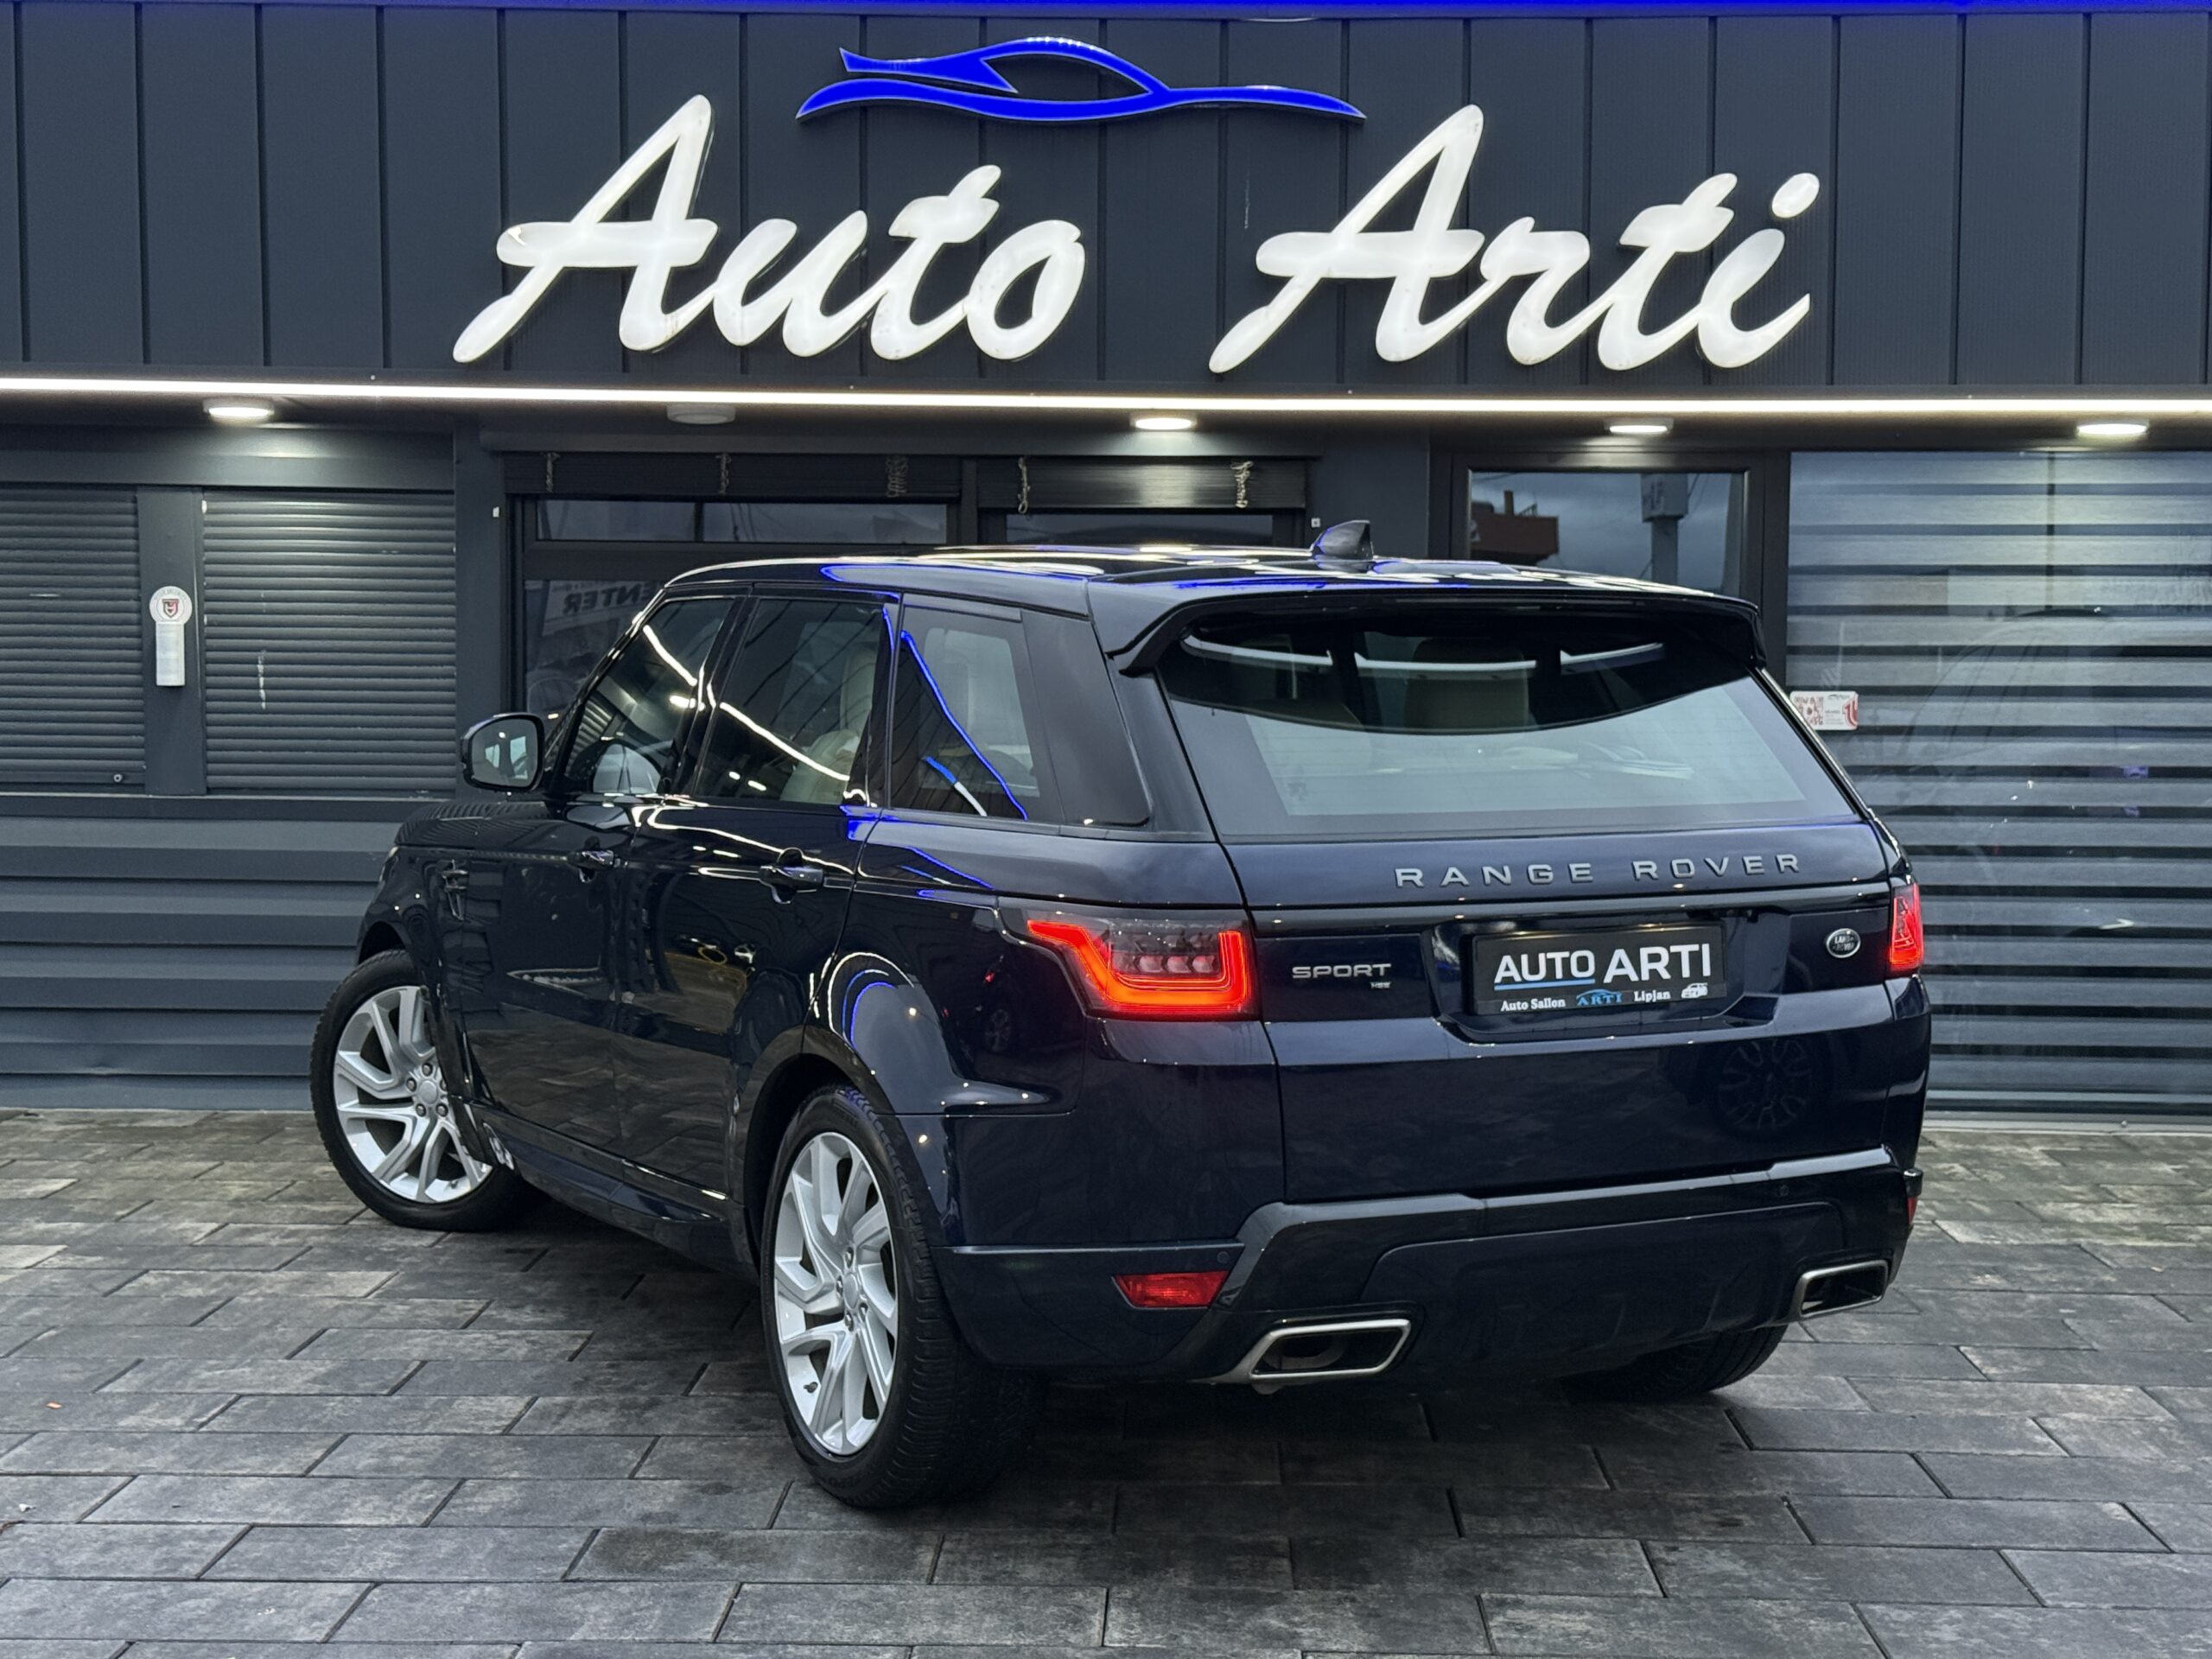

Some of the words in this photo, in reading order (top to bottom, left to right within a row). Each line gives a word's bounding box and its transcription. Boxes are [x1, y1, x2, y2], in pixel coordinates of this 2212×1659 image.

[453, 95, 1085, 363] Auto
[1209, 105, 1821, 373] Arti
[1394, 862, 1596, 889] RANGE
[1631, 853, 1802, 880] ROVER
[1291, 963, 1392, 979] SPORT
[1493, 950, 1597, 984] AUTO
[1603, 943, 1712, 984] ARTI
[1500, 1000, 1529, 1012] Auto
[1530, 997, 1567, 1010] Sallon
[1576, 993, 1623, 1007] ARTI
[1633, 989, 1671, 1003] Lipjan
